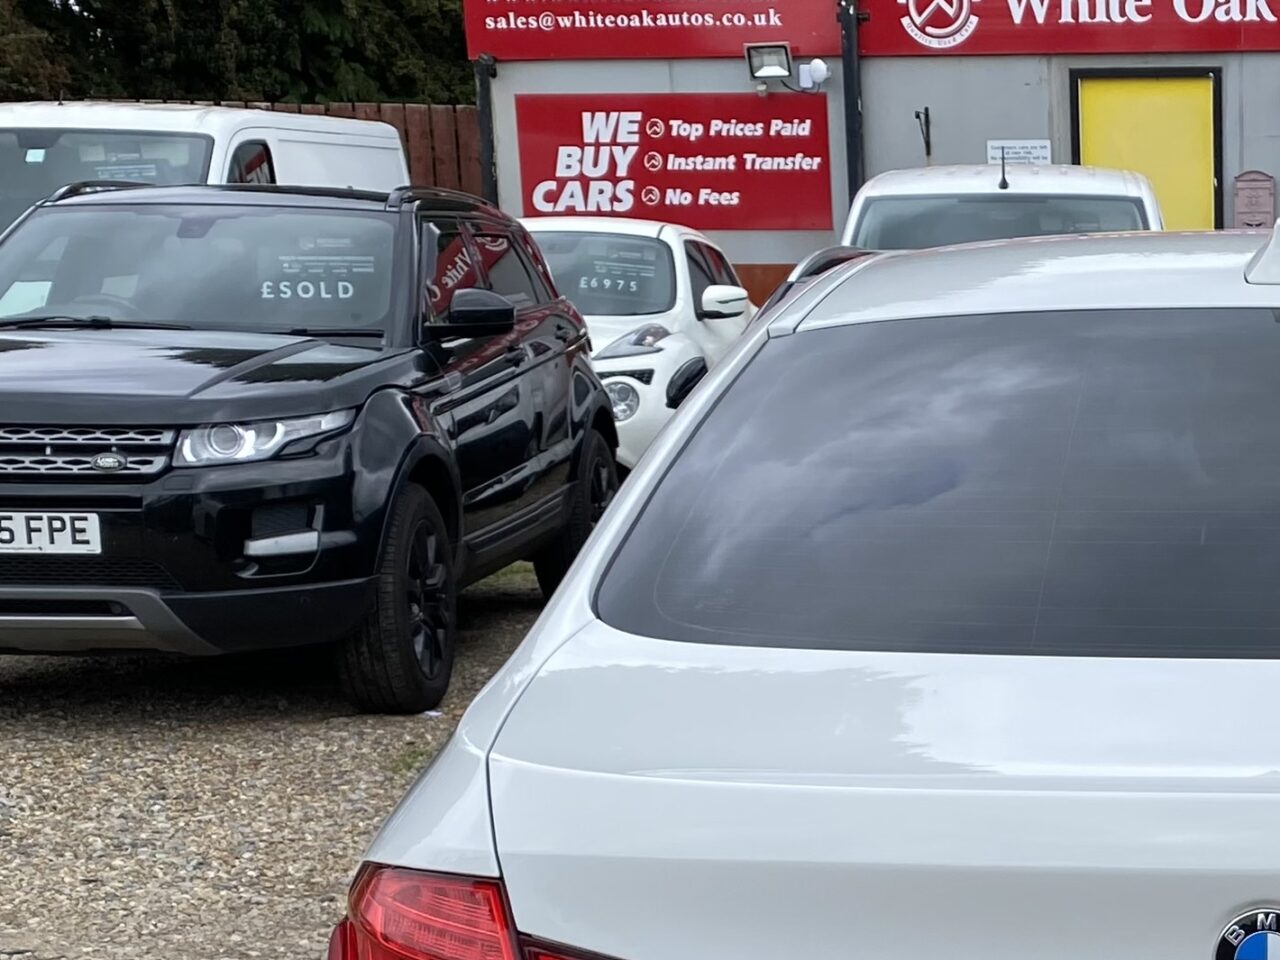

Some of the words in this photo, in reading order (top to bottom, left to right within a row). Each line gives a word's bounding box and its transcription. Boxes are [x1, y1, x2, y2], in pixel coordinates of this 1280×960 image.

[485, 9, 783, 30] sales@whiteoakautos.co.uk
[1009, 0, 1153, 25] White
[1173, 0, 1278, 22] Oak
[581, 112, 642, 143] WE
[669, 120, 703, 140] Top
[709, 120, 763, 137] Prices
[769, 119, 811, 136] Paid
[556, 146, 638, 177] BUY
[666, 154, 736, 170] Instant
[743, 153, 821, 170] Transfer
[532, 180, 634, 212] CARS
[665, 189, 692, 205] No
[698, 189, 740, 205] Fees
[24, 515, 91, 545] FPE
